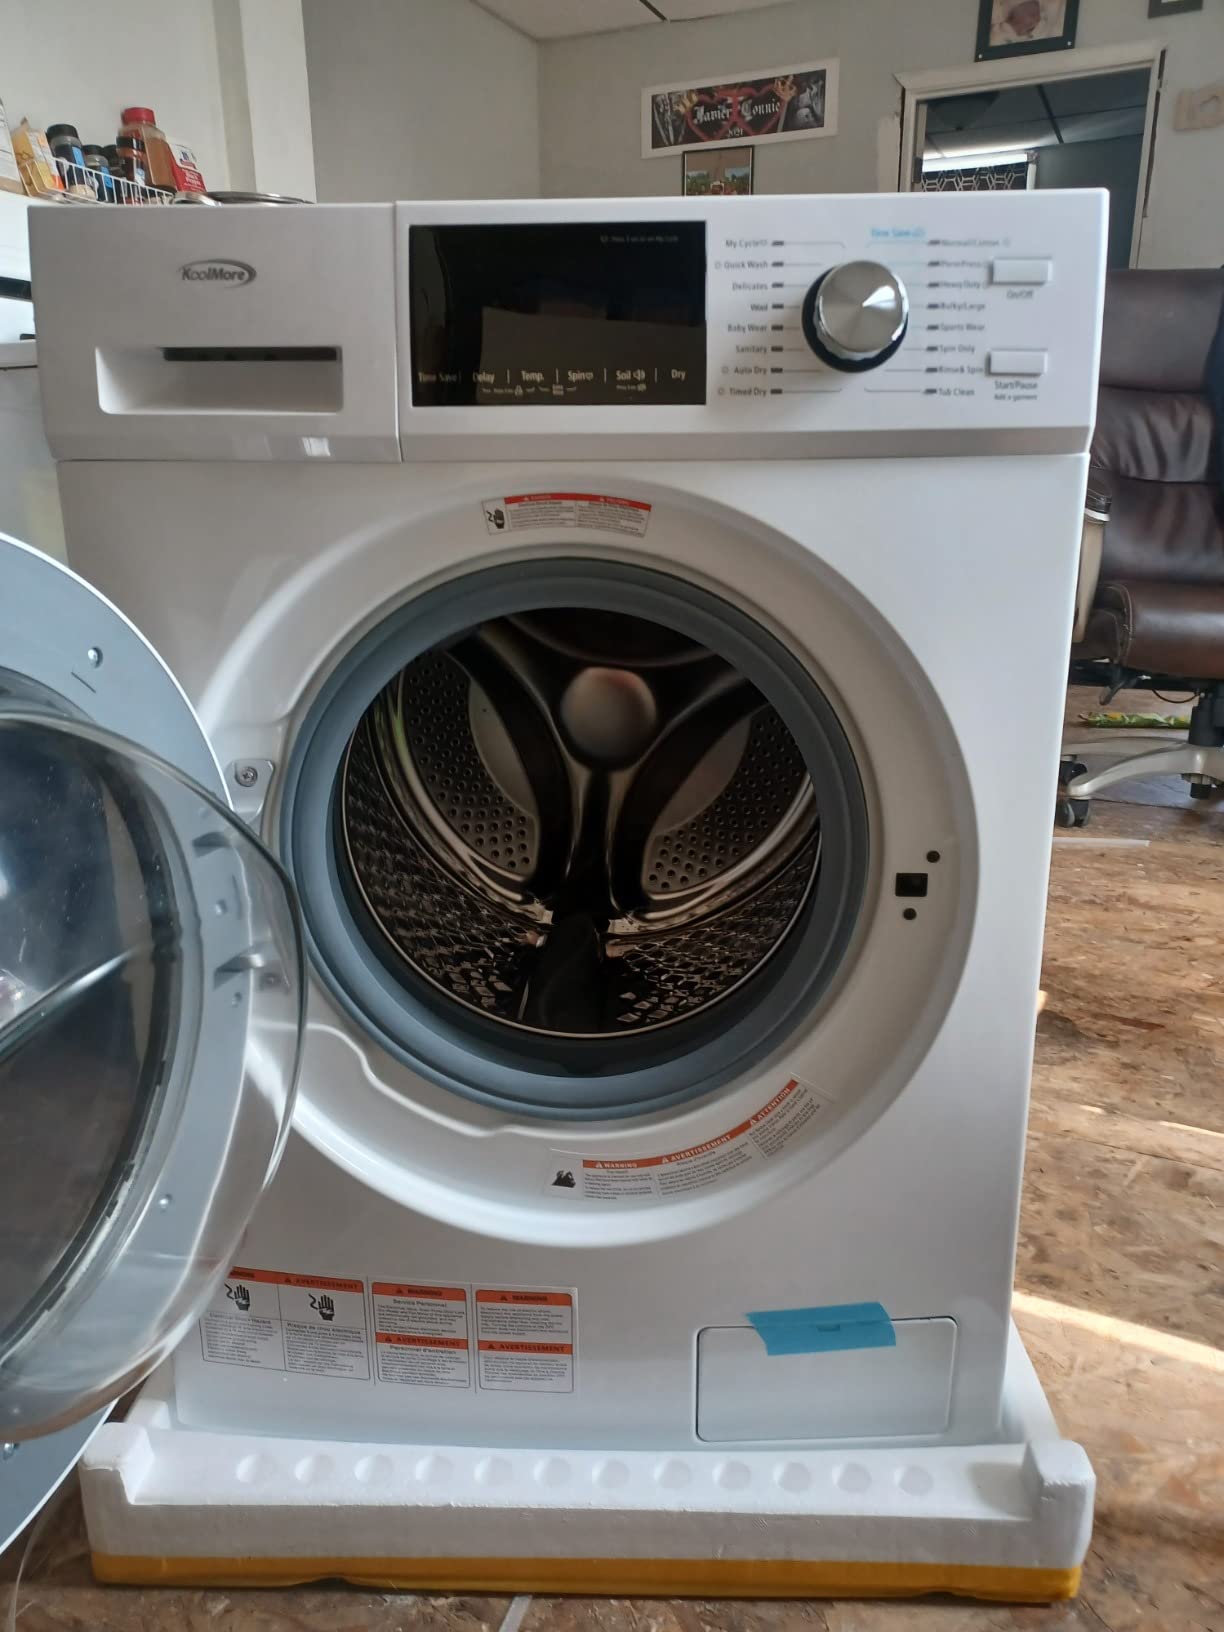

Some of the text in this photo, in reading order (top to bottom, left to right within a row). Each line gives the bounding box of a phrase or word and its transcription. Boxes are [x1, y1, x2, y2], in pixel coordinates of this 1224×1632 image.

[740, 98, 781, 121] Connie
[725, 239, 737, 249] My
[724, 261, 769, 270] Quick Wash
[181, 265, 246, 281] KoolMore
[732, 282, 769, 291] Delicates
[1006, 289, 1034, 299] On/Off
[727, 323, 768, 333] Baby Wear
[736, 344, 768, 354] Sanitary
[616, 370, 631, 381] Soil
[671, 368, 686, 381] Dry
[734, 366, 768, 375] Auto Dry
[994, 380, 1038, 390] Start/Pause
[730, 387, 767, 396] Timed Dry
[953, 387, 975, 396] Clean
[604, 1161, 638, 1169] WARNING
